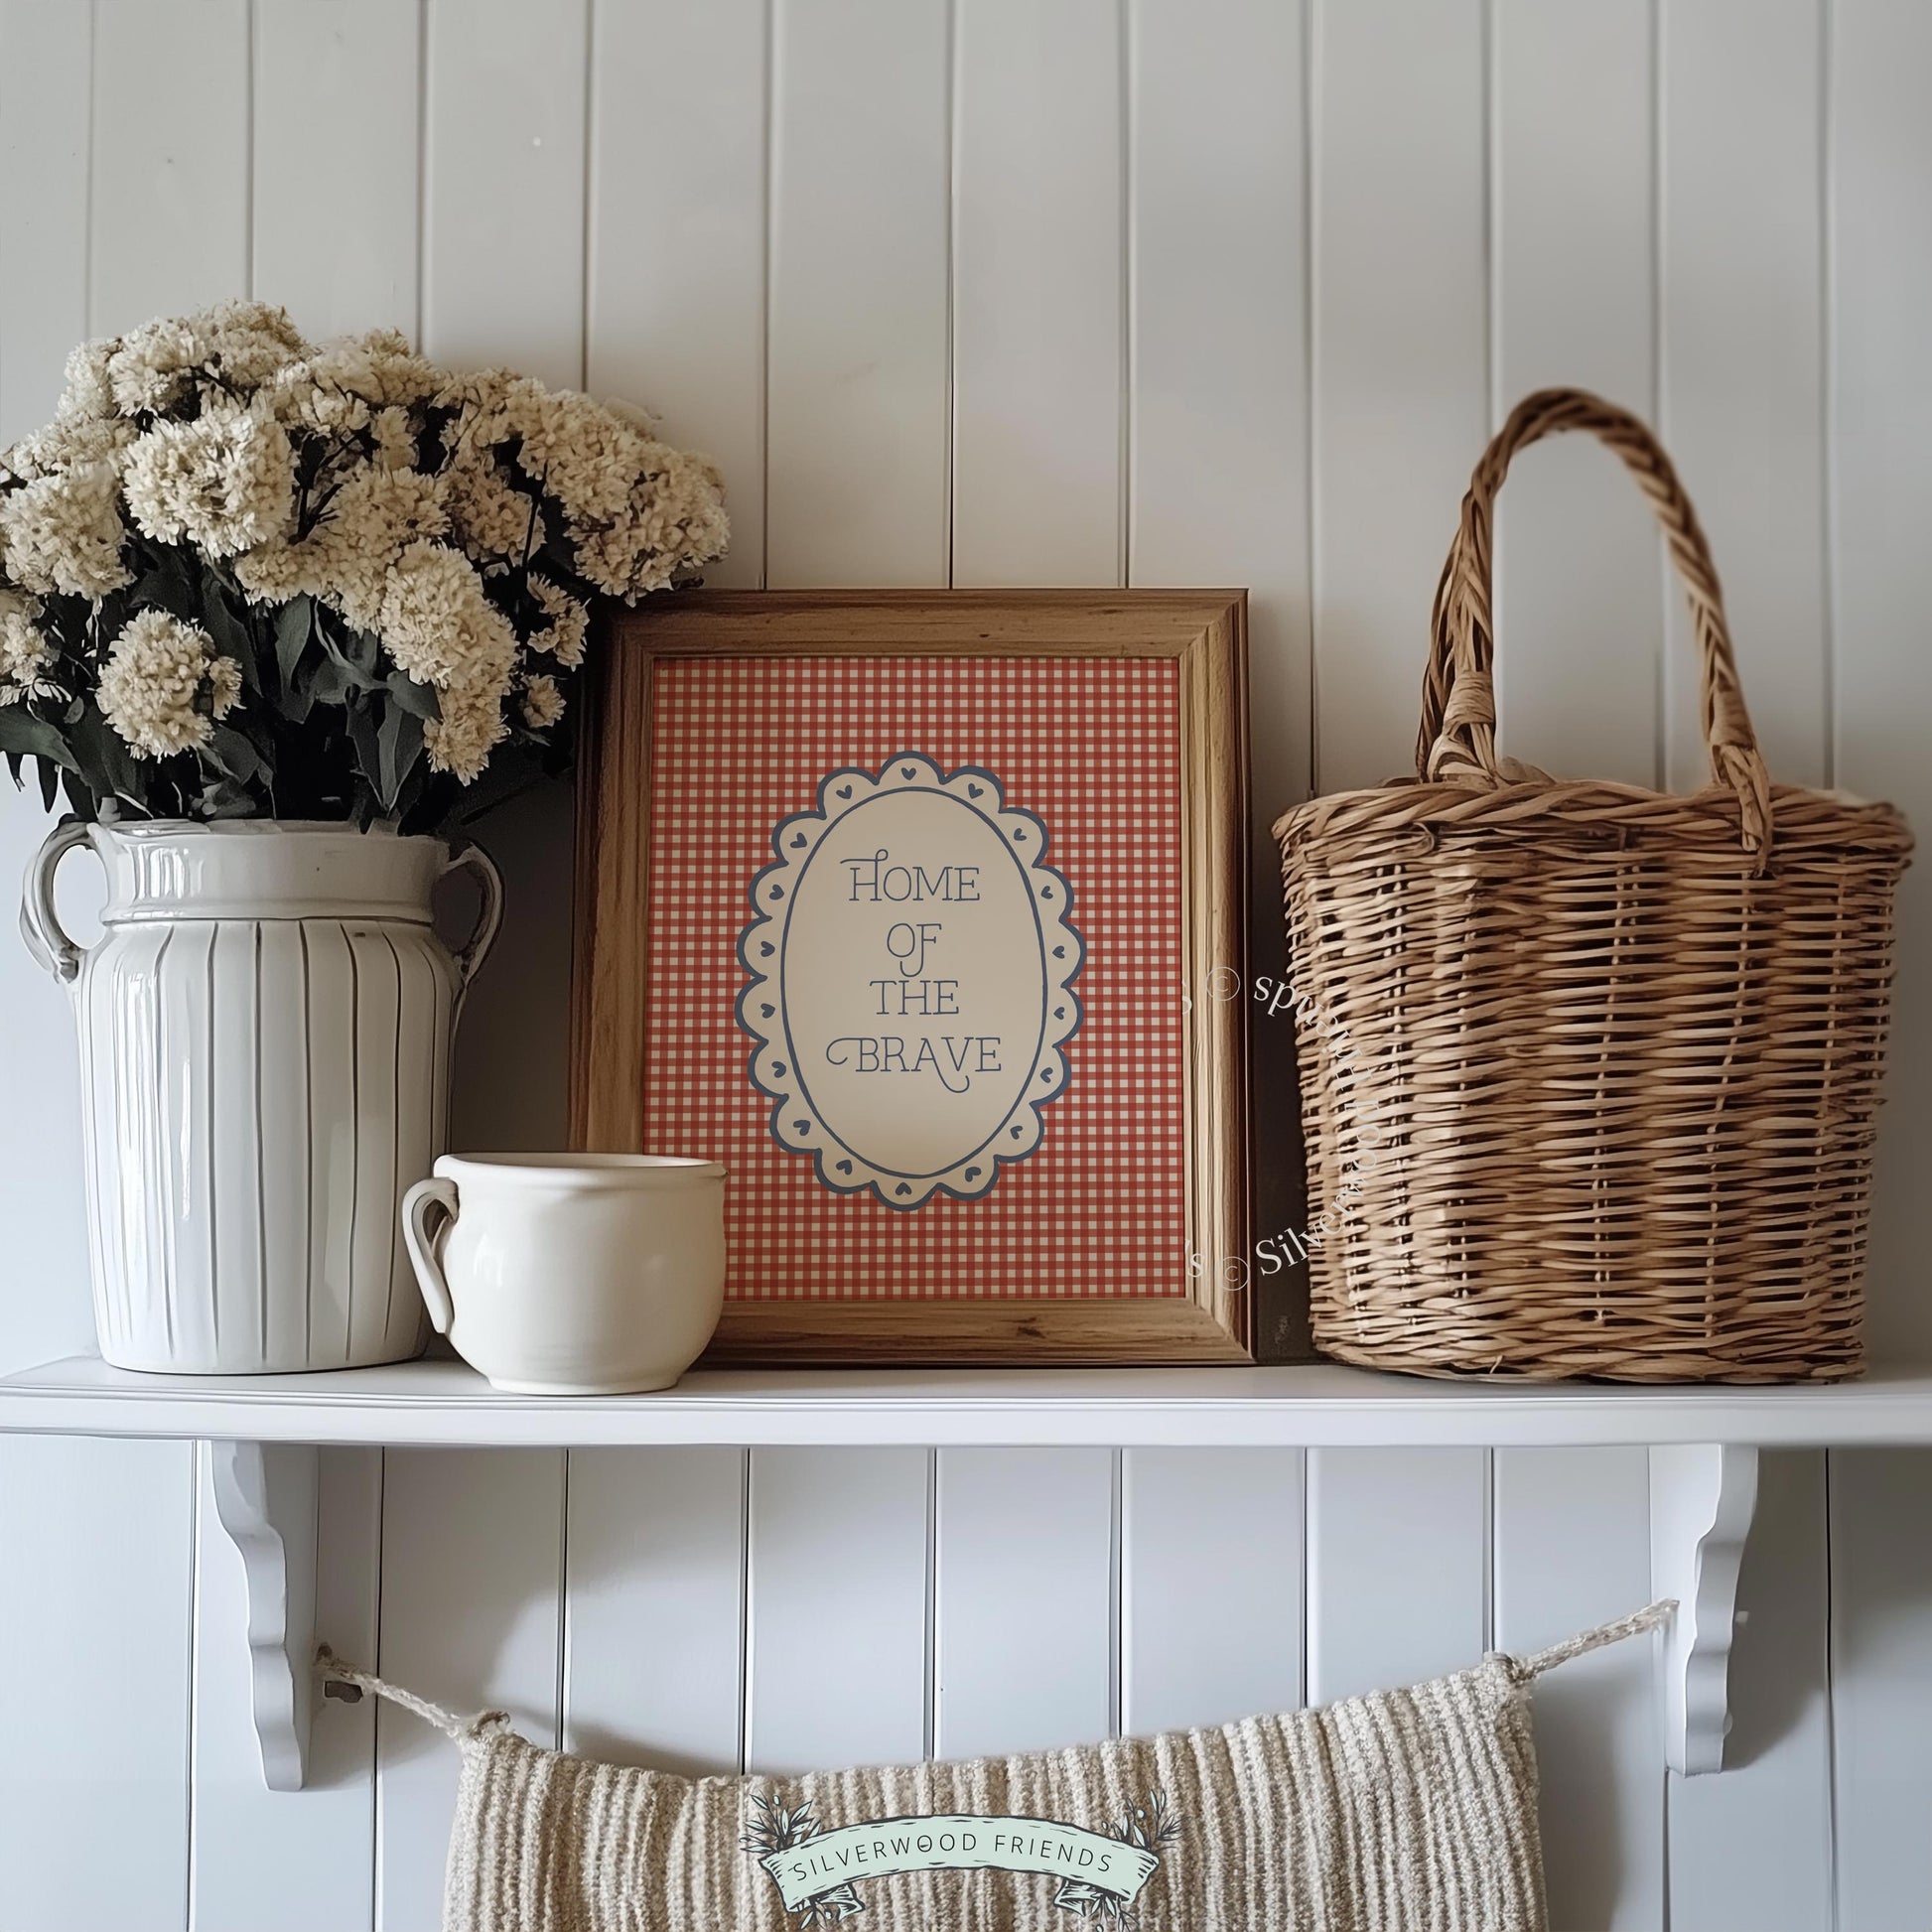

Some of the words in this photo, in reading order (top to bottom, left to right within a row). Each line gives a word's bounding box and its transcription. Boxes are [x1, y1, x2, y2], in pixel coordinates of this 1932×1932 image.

[840, 849, 981, 901] HOME
[887, 922, 942, 977] OF
[869, 980, 960, 1016] THE
[825, 1036, 1002, 1094] BRAVE
